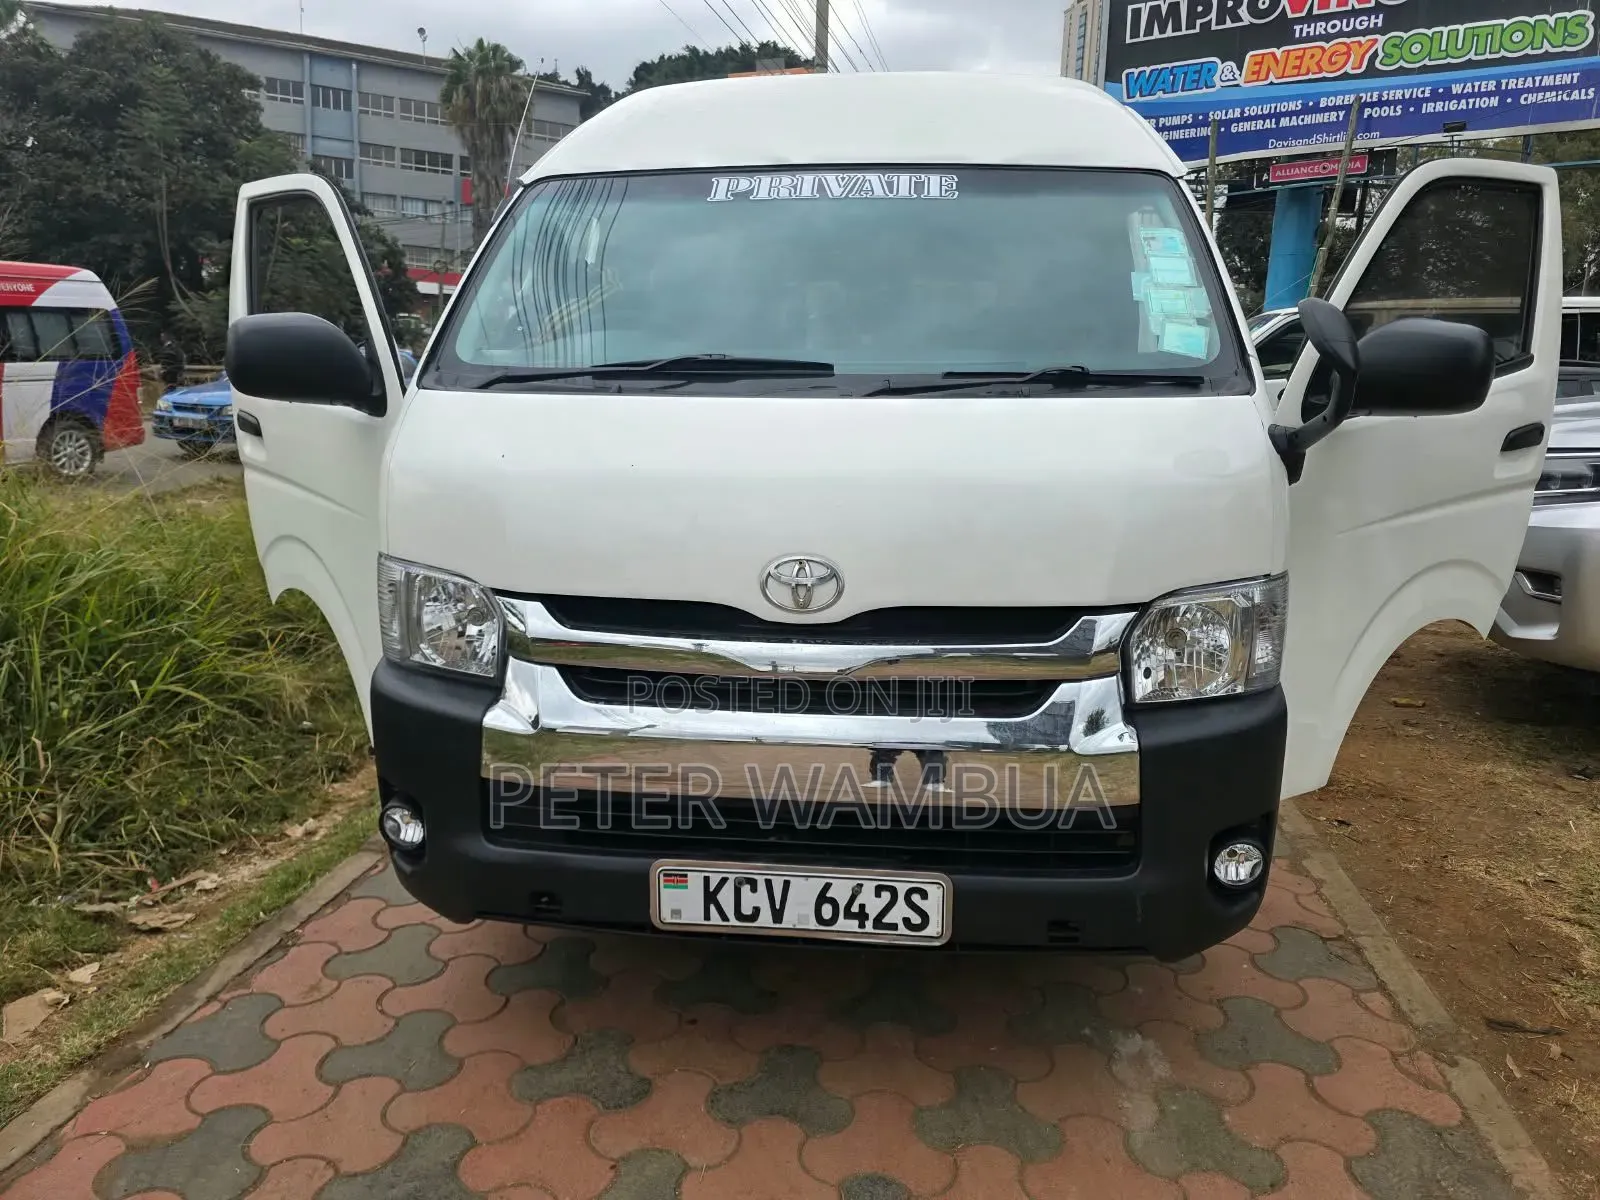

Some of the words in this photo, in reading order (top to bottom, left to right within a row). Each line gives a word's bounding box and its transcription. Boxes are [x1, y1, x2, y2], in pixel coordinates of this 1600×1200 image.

[1294, 13, 1384, 38] THROUGH
[1125, 60, 1219, 100] WATER
[1220, 64, 1241, 82] &
[1243, 37, 1379, 84] ENERGY
[1379, 13, 1591, 67] SOLUTIONS
[1158, 113, 1193, 127] PUMPS
[1208, 108, 1241, 122] SOLAR
[1243, 100, 1302, 117] SOLUTIONS
[1381, 86, 1432, 101] SERVICE
[1451, 79, 1496, 95] WATER
[1500, 72, 1580, 90] TREATMENT
[1230, 117, 1276, 133] GENERAL
[1279, 110, 1346, 128] MACHINERY
[1363, 105, 1402, 118] POOLS
[1421, 96, 1499, 114] IRRIGATION
[1519, 87, 1596, 105] CHEMICALS
[1268, 131, 1380, 149] DavisandShirtli.com
[707, 173, 959, 202] PRIVATE
[1275, 164, 1320, 177] ALLIANCE
[702, 875, 791, 925] KCV
[813, 881, 930, 933] 642S
